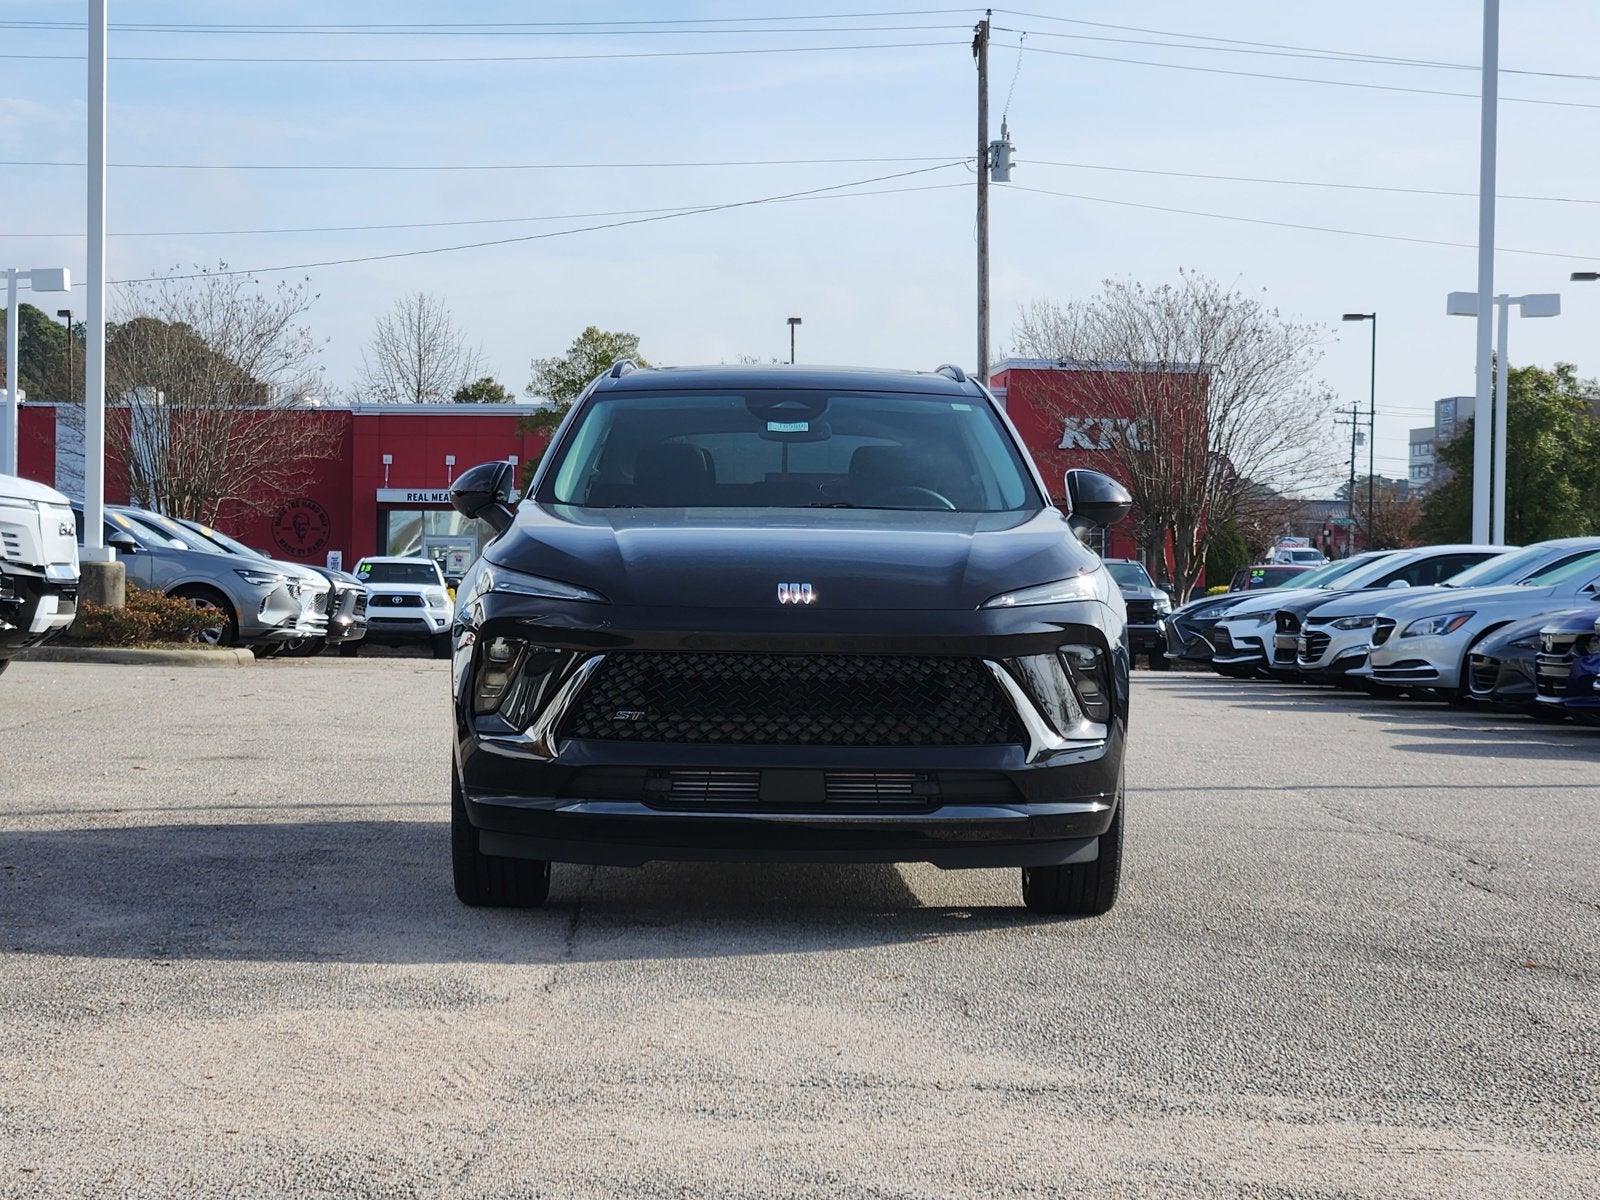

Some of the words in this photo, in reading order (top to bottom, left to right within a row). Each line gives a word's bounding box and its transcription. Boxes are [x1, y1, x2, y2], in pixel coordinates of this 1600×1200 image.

[1057, 416, 1151, 452] KFC
[407, 493, 429, 502] REAL
[431, 493, 450, 502] MEA
[613, 711, 645, 720] ST
